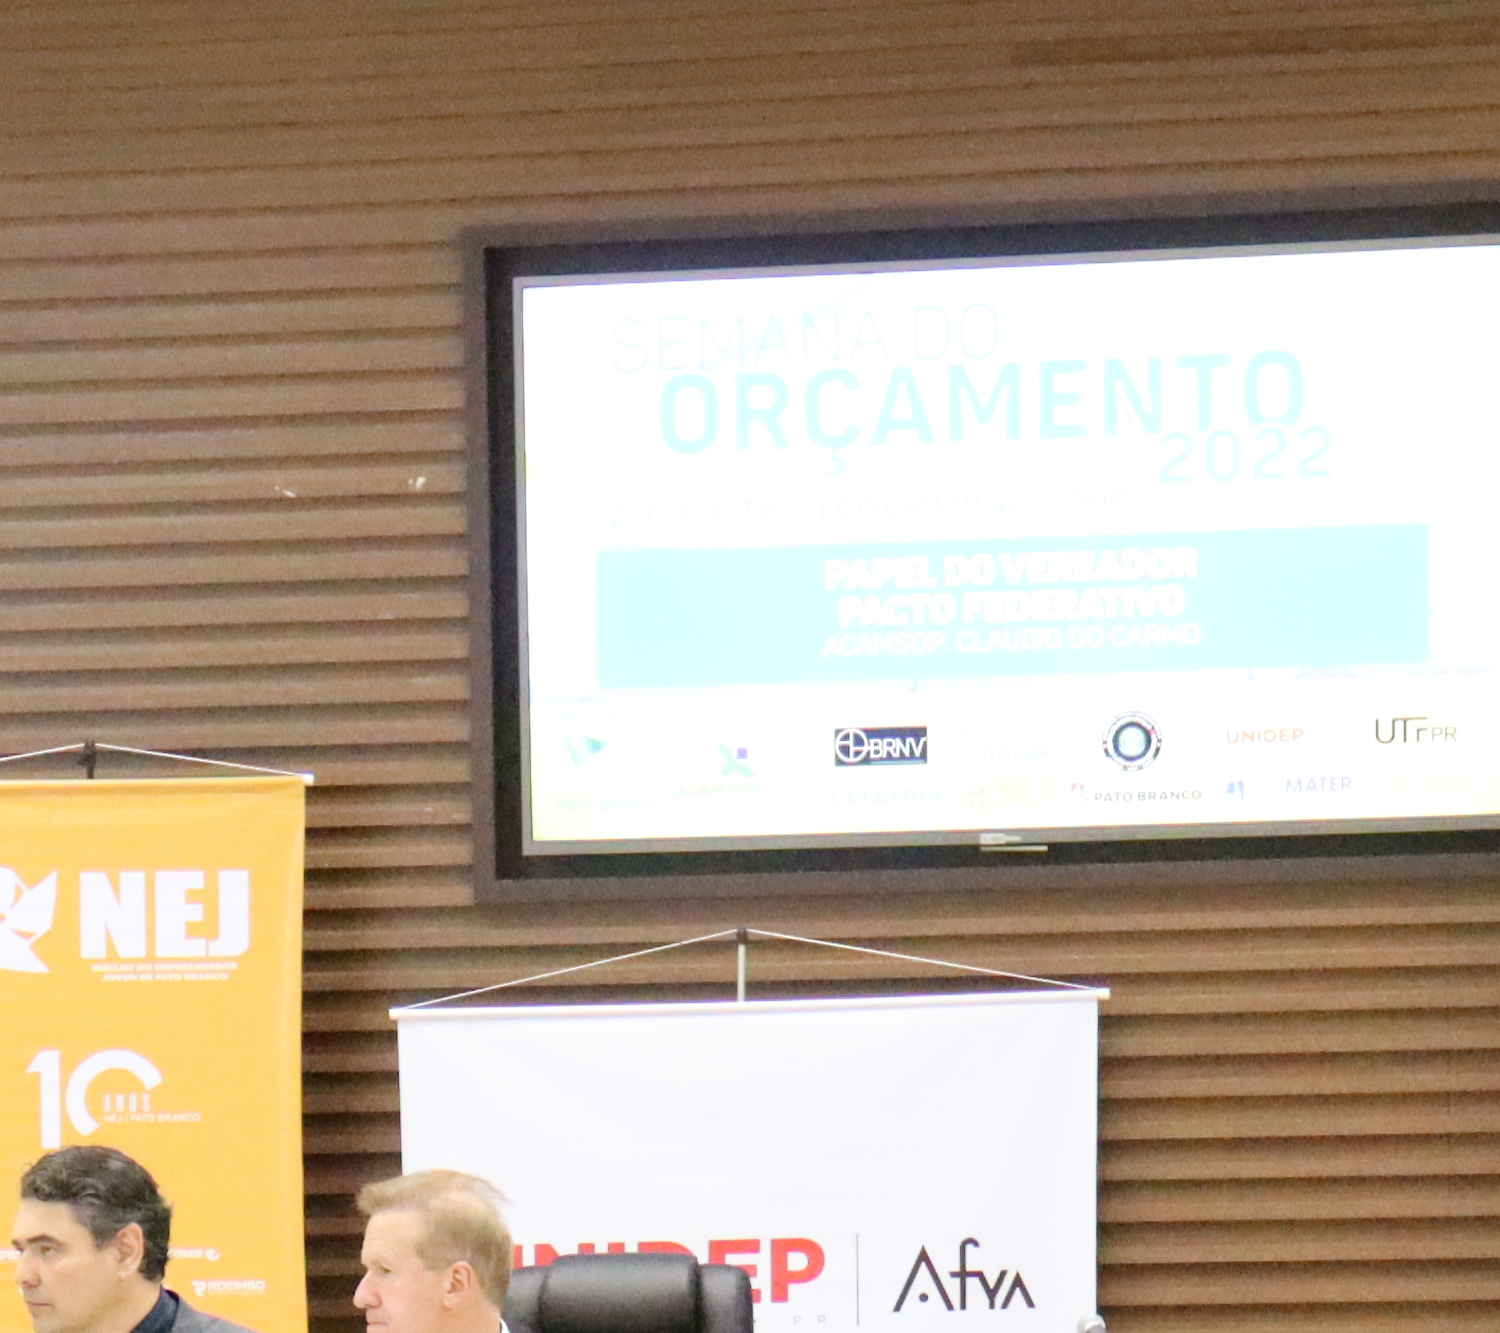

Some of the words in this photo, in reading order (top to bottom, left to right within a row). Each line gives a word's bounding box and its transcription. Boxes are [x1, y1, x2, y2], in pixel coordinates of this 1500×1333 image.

[611, 309, 890, 373] SEMANA
[912, 303, 999, 361] DO
[659, 349, 1305, 475] ORÇAMENTO
[1160, 425, 1334, 484] 2022
[824, 552, 939, 592] PAPEL
[943, 551, 996, 587] DO
[999, 546, 1198, 585] VEREADOR
[837, 589, 955, 628] PACTO
[962, 583, 1185, 624] FEDERATIVO
[955, 624, 1062, 654] CLAUDIO
[1067, 624, 1105, 649] DO
[1109, 621, 1202, 649] CARMO
[869, 736, 928, 759] BRNV
[1226, 727, 1305, 745] UNIDEP
[1093, 790, 1134, 804] PATO
[1137, 787, 1203, 802] BRANCO
[79, 869, 251, 960] NEJ
[103, 1092, 151, 1113] ANOS
[892, 1236, 1036, 1313] Afya
